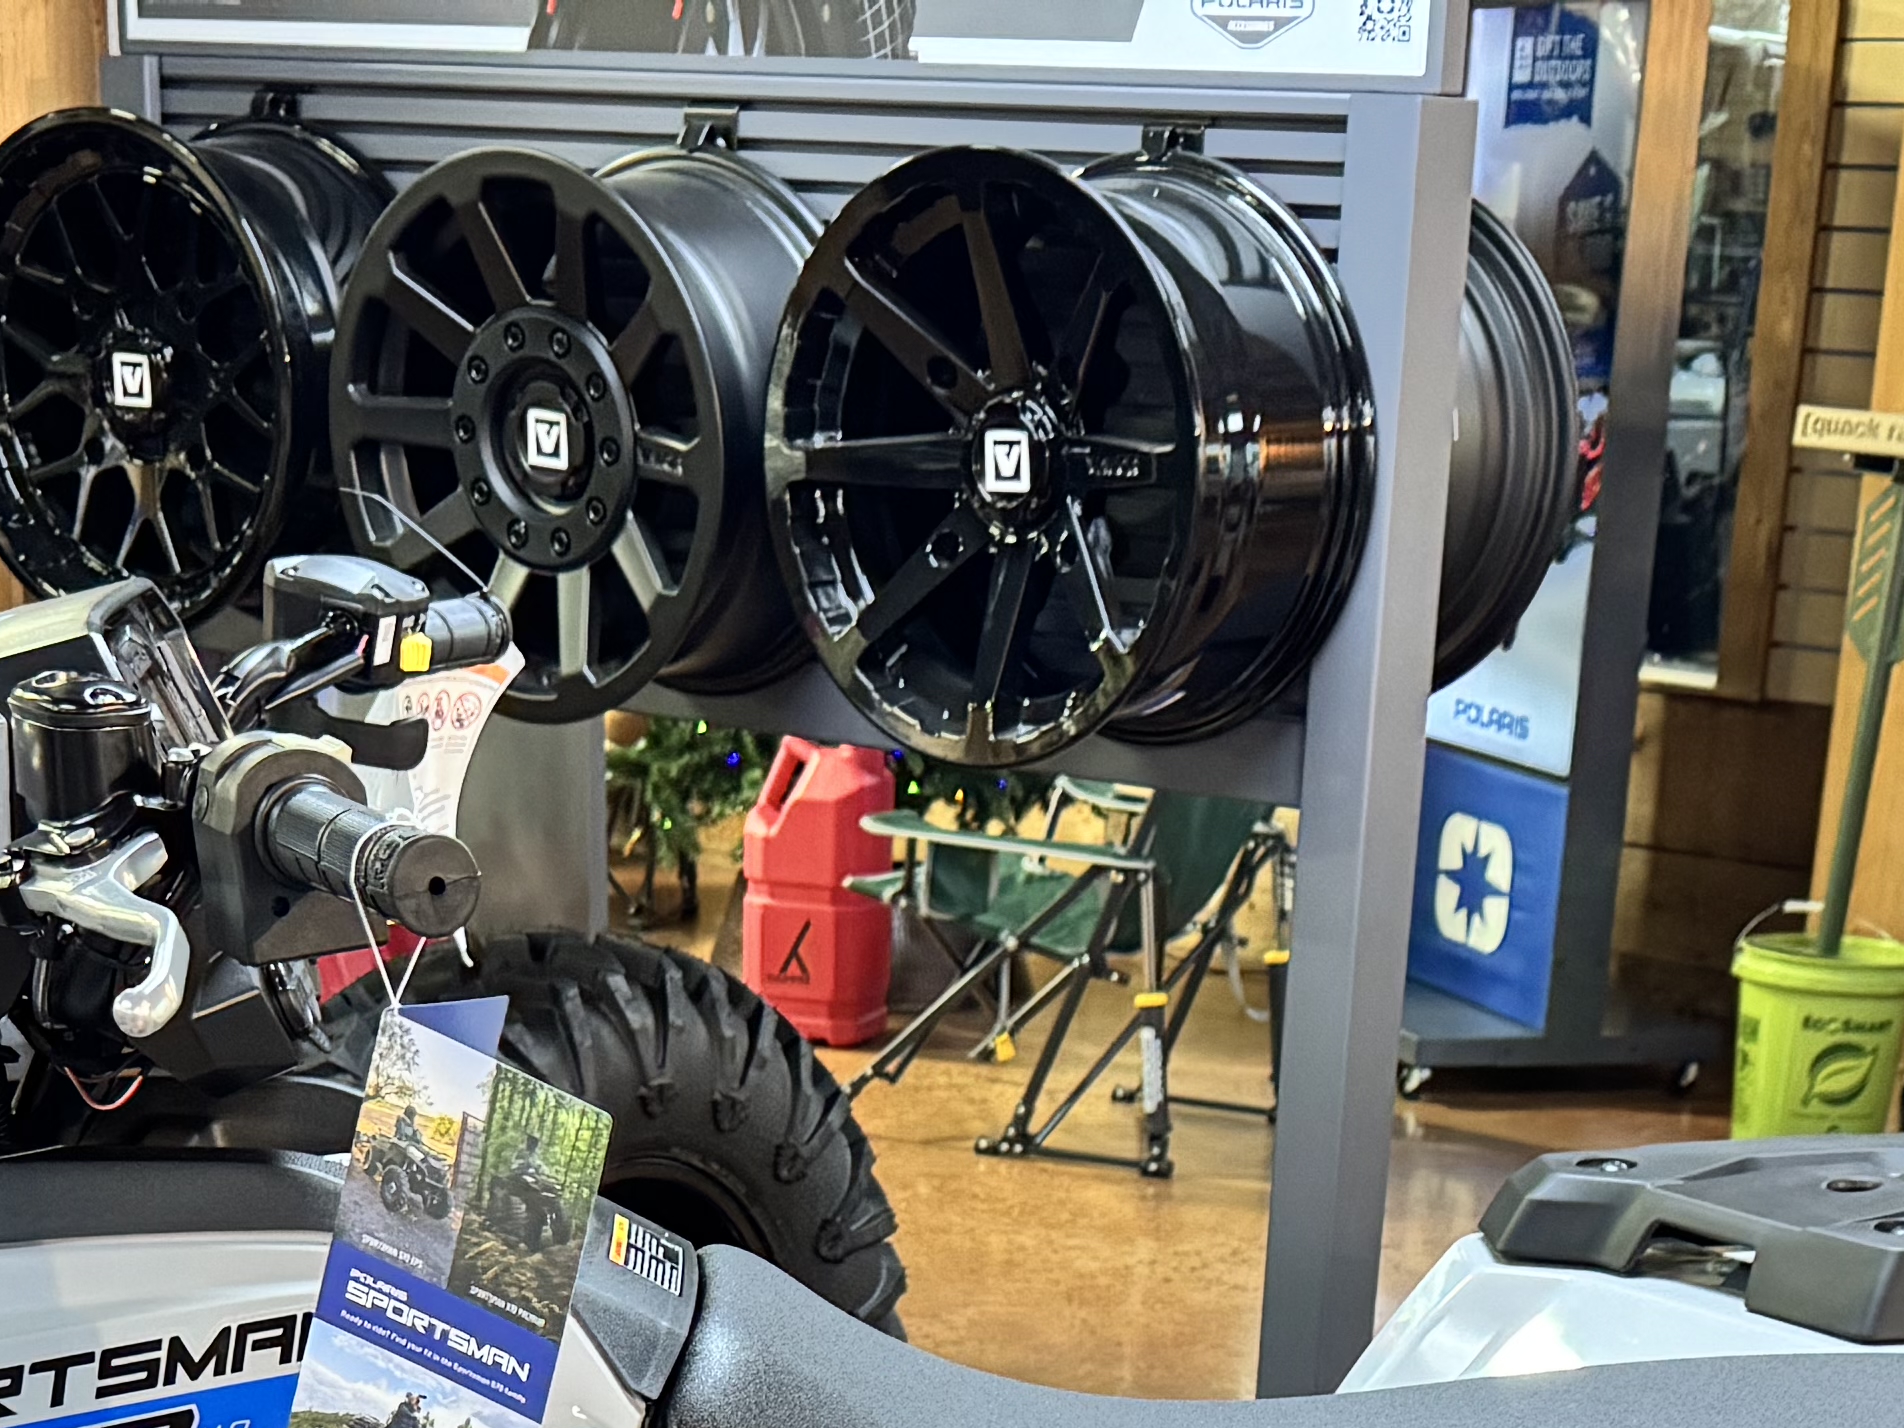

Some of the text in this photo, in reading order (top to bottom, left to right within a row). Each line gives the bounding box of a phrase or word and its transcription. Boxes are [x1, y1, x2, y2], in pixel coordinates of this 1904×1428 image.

[1453, 698, 1530, 742] POLARIS
[349, 1267, 408, 1301] POLARIS
[344, 1279, 531, 1383] SPORTSMAN
